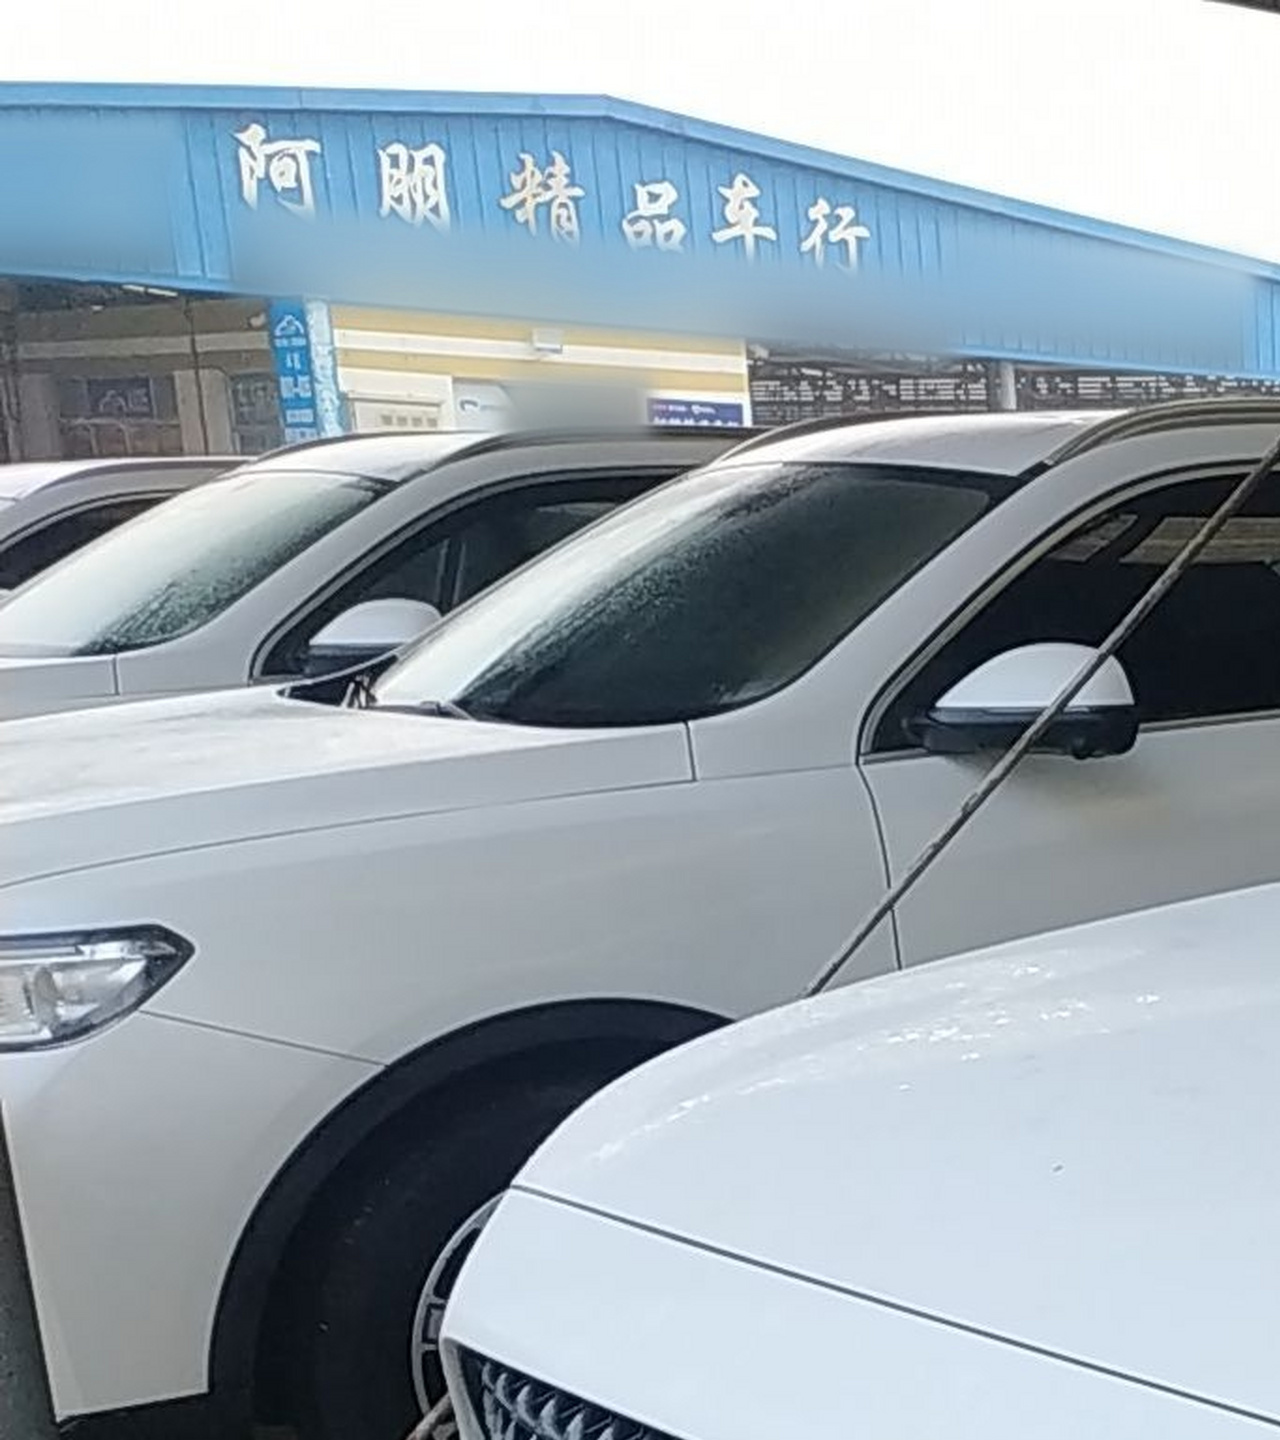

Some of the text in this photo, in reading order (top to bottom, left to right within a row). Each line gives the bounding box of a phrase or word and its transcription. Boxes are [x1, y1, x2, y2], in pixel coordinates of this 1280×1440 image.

[229, 122, 872, 275] 阿朋精品车行
